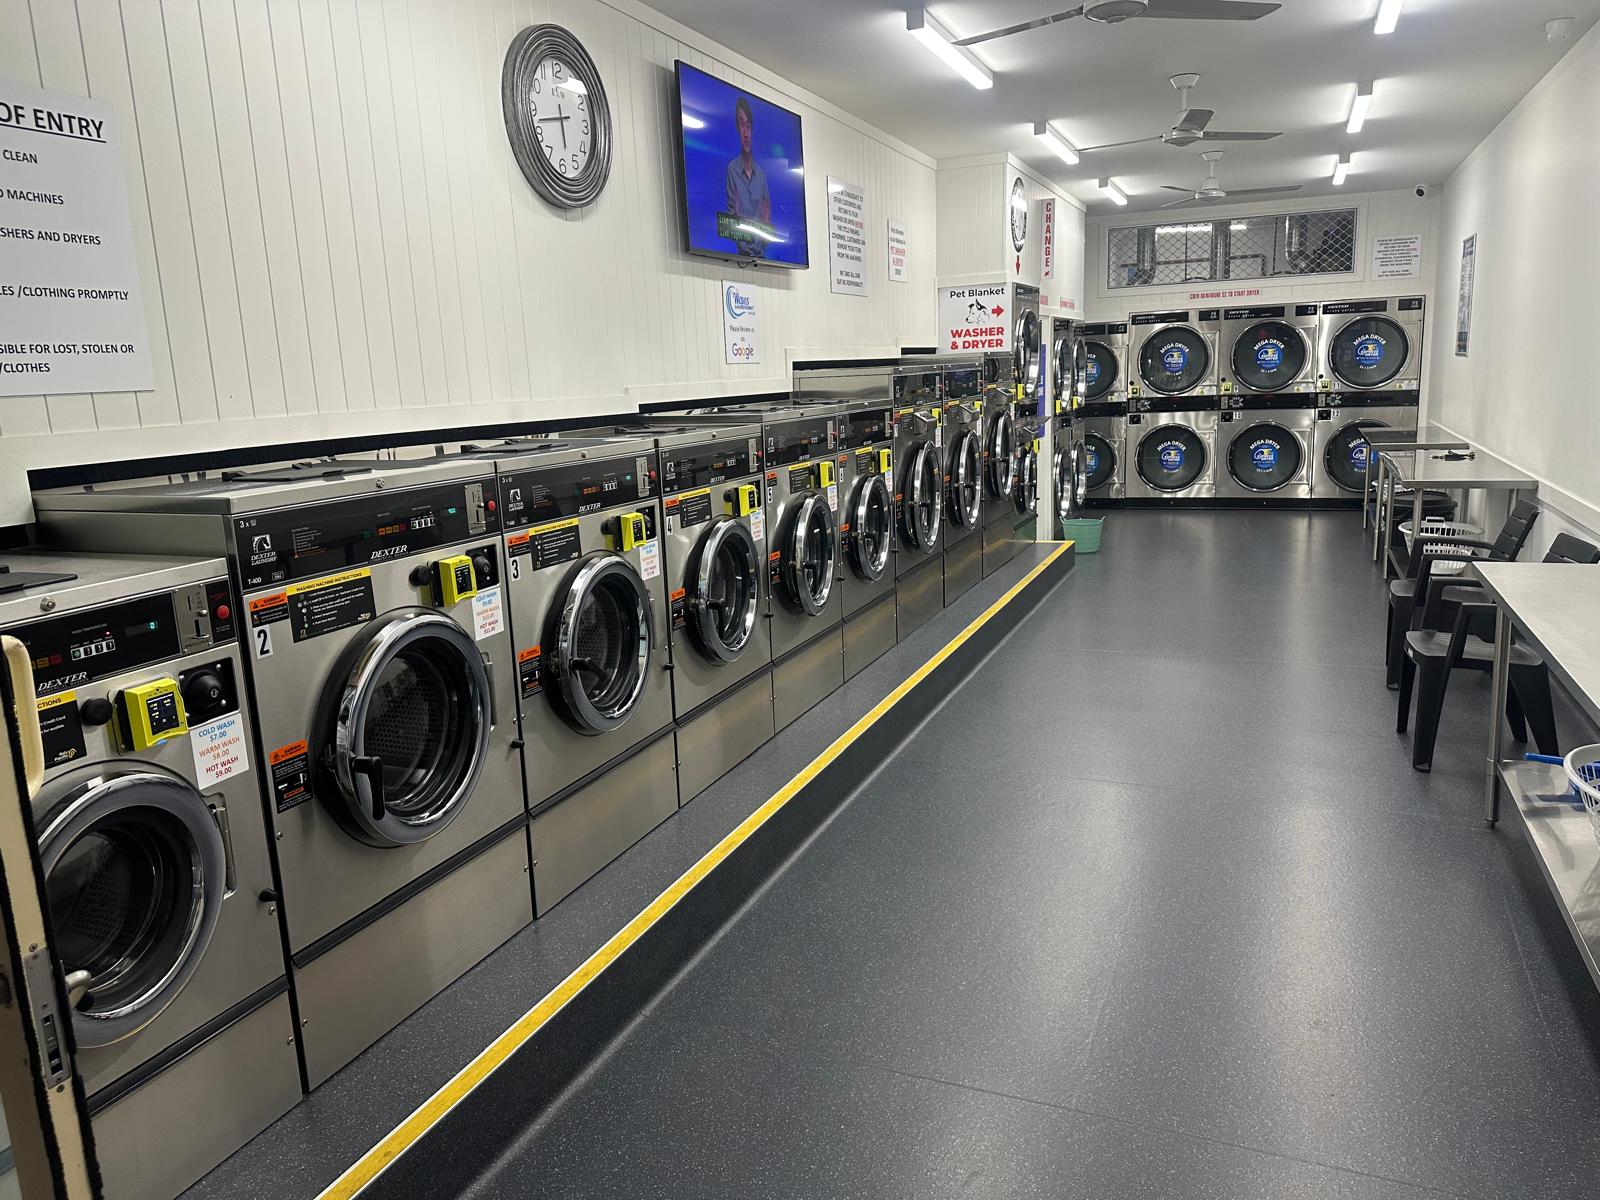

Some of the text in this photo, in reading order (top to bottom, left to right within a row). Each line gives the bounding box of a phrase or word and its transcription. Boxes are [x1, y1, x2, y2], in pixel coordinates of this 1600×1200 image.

[551, 61, 562, 80] 12
[534, 78, 541, 94] 0
[578, 95, 584, 111] 2
[0, 102, 104, 138] OF ENTRY
[582, 120, 589, 135] 3
[536, 126, 544, 142] 8
[545, 145, 553, 160] 7
[580, 140, 586, 156] 4
[3, 150, 38, 164] CLEAN
[572, 154, 578, 170] 5
[559, 158, 567, 174] 6
[7, 190, 64, 205] MACHINES
[38, 230, 60, 242] AND
[63, 233, 101, 245] DRYERS
[18, 284, 75, 299] /CLOTHING
[78, 289, 129, 301] PROMPTLY
[950, 288, 1005, 298] Pet Blanket
[951, 326, 1005, 338] WASHER
[951, 338, 1004, 350] & DRYER
[1254, 339, 1285, 350] MEGA DRYER
[1353, 334, 1387, 346] MEGA DRYER
[29, 344, 50, 354] FOR
[52, 344, 80, 355] LOST,
[82, 344, 118, 354] STOLEN
[120, 344, 134, 353] OR
[732, 343, 754, 360] Google
[1160, 343, 1190, 353] MEGA DRYER
[1157, 440, 1186, 451] MEGA DRYER
[1250, 439, 1280, 449] MEGA DRYER
[1348, 438, 1365, 448] MEGA
[579, 503, 601, 512] DEXTER
[668, 518, 672, 534] 4
[250, 552, 276, 560] DEXTER
[370, 544, 408, 559] DEXTER
[251, 556, 278, 565] LAUNDRY
[512, 559, 519, 579] 3
[296, 584, 315, 592] WASHING
[334, 573, 362, 582] INSTRUCTIONS
[257, 629, 270, 656] 2
[38, 672, 88, 692] DEXTER
[198, 720, 235, 737] COLD WASH
[210, 731, 227, 742] $7.00
[199, 736, 240, 757] WARM WASH
[213, 749, 230, 760] $8.00
[206, 756, 239, 773] HOT WASH
[215, 767, 232, 778] $9.00
